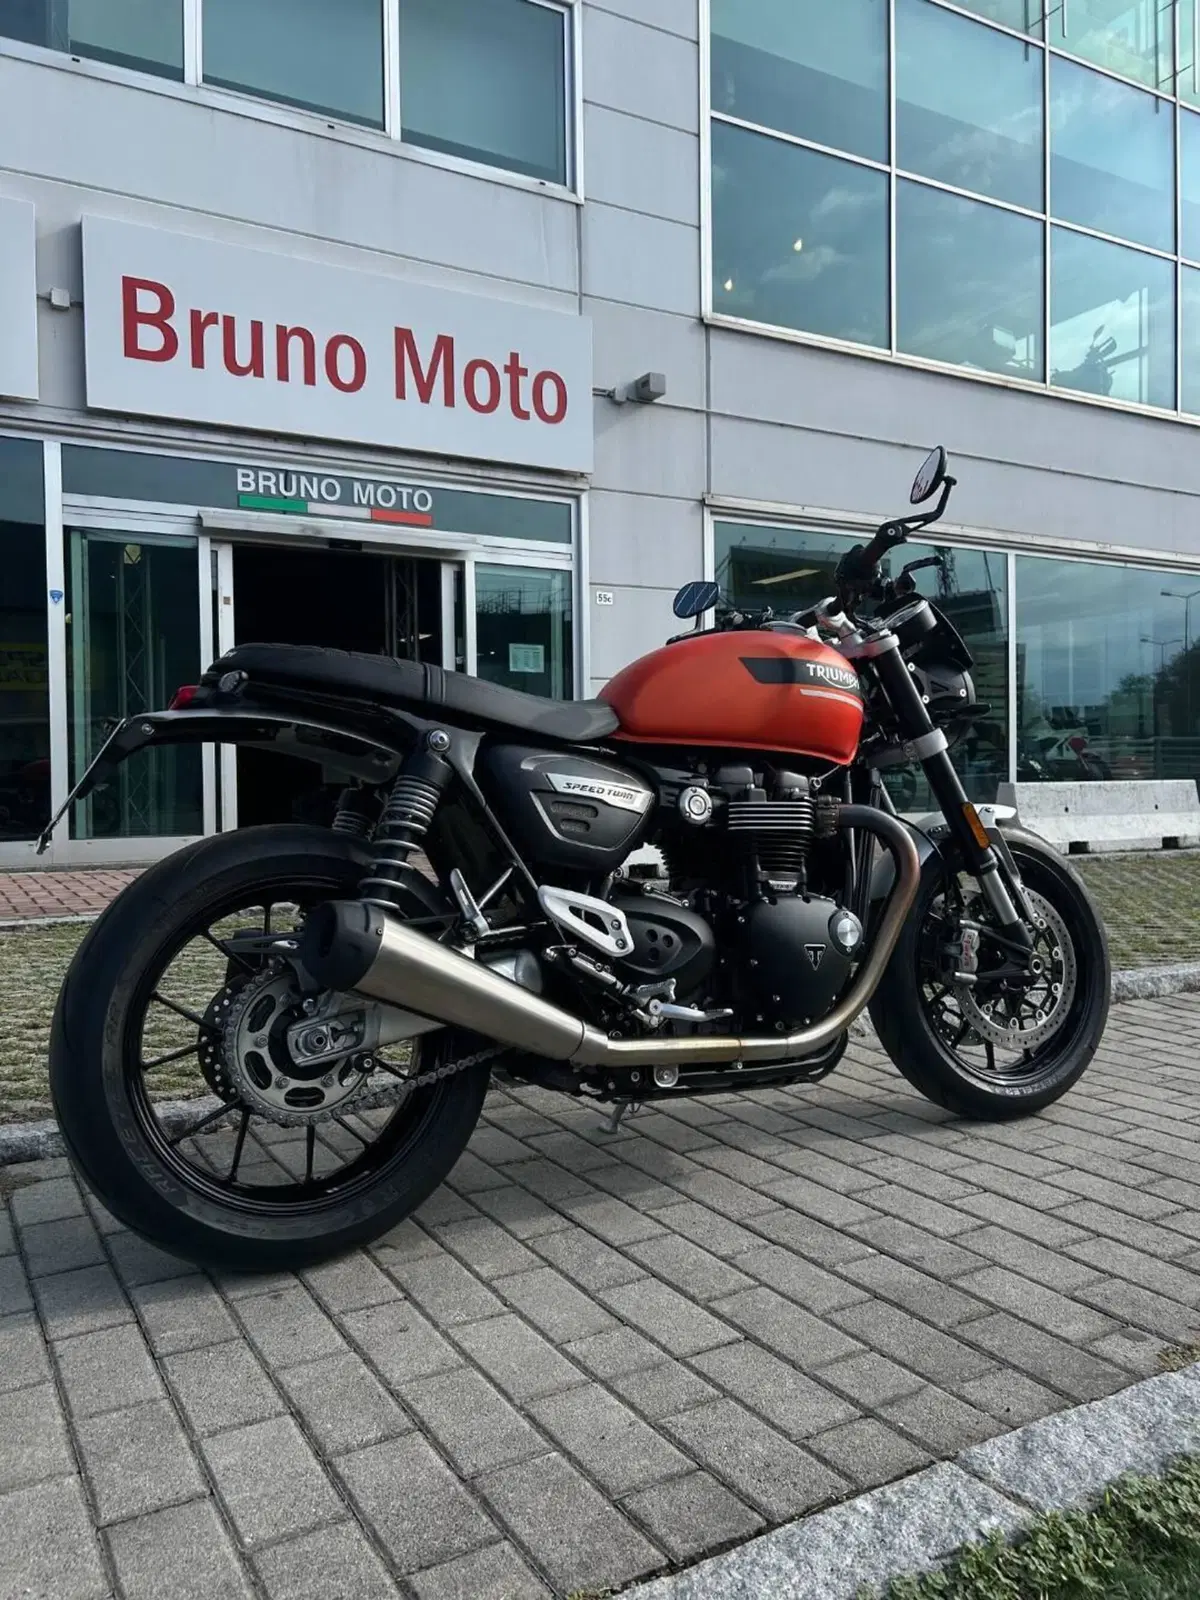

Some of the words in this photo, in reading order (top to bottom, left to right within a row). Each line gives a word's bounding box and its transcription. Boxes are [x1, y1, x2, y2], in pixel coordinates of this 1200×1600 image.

[122, 276, 367, 393] Bruno
[395, 327, 567, 423] Moto
[236, 468, 341, 501] BRUNO
[353, 481, 433, 512] MOTO
[806, 663, 860, 690] TRIUMPH
[562, 782, 605, 794] SPEED
